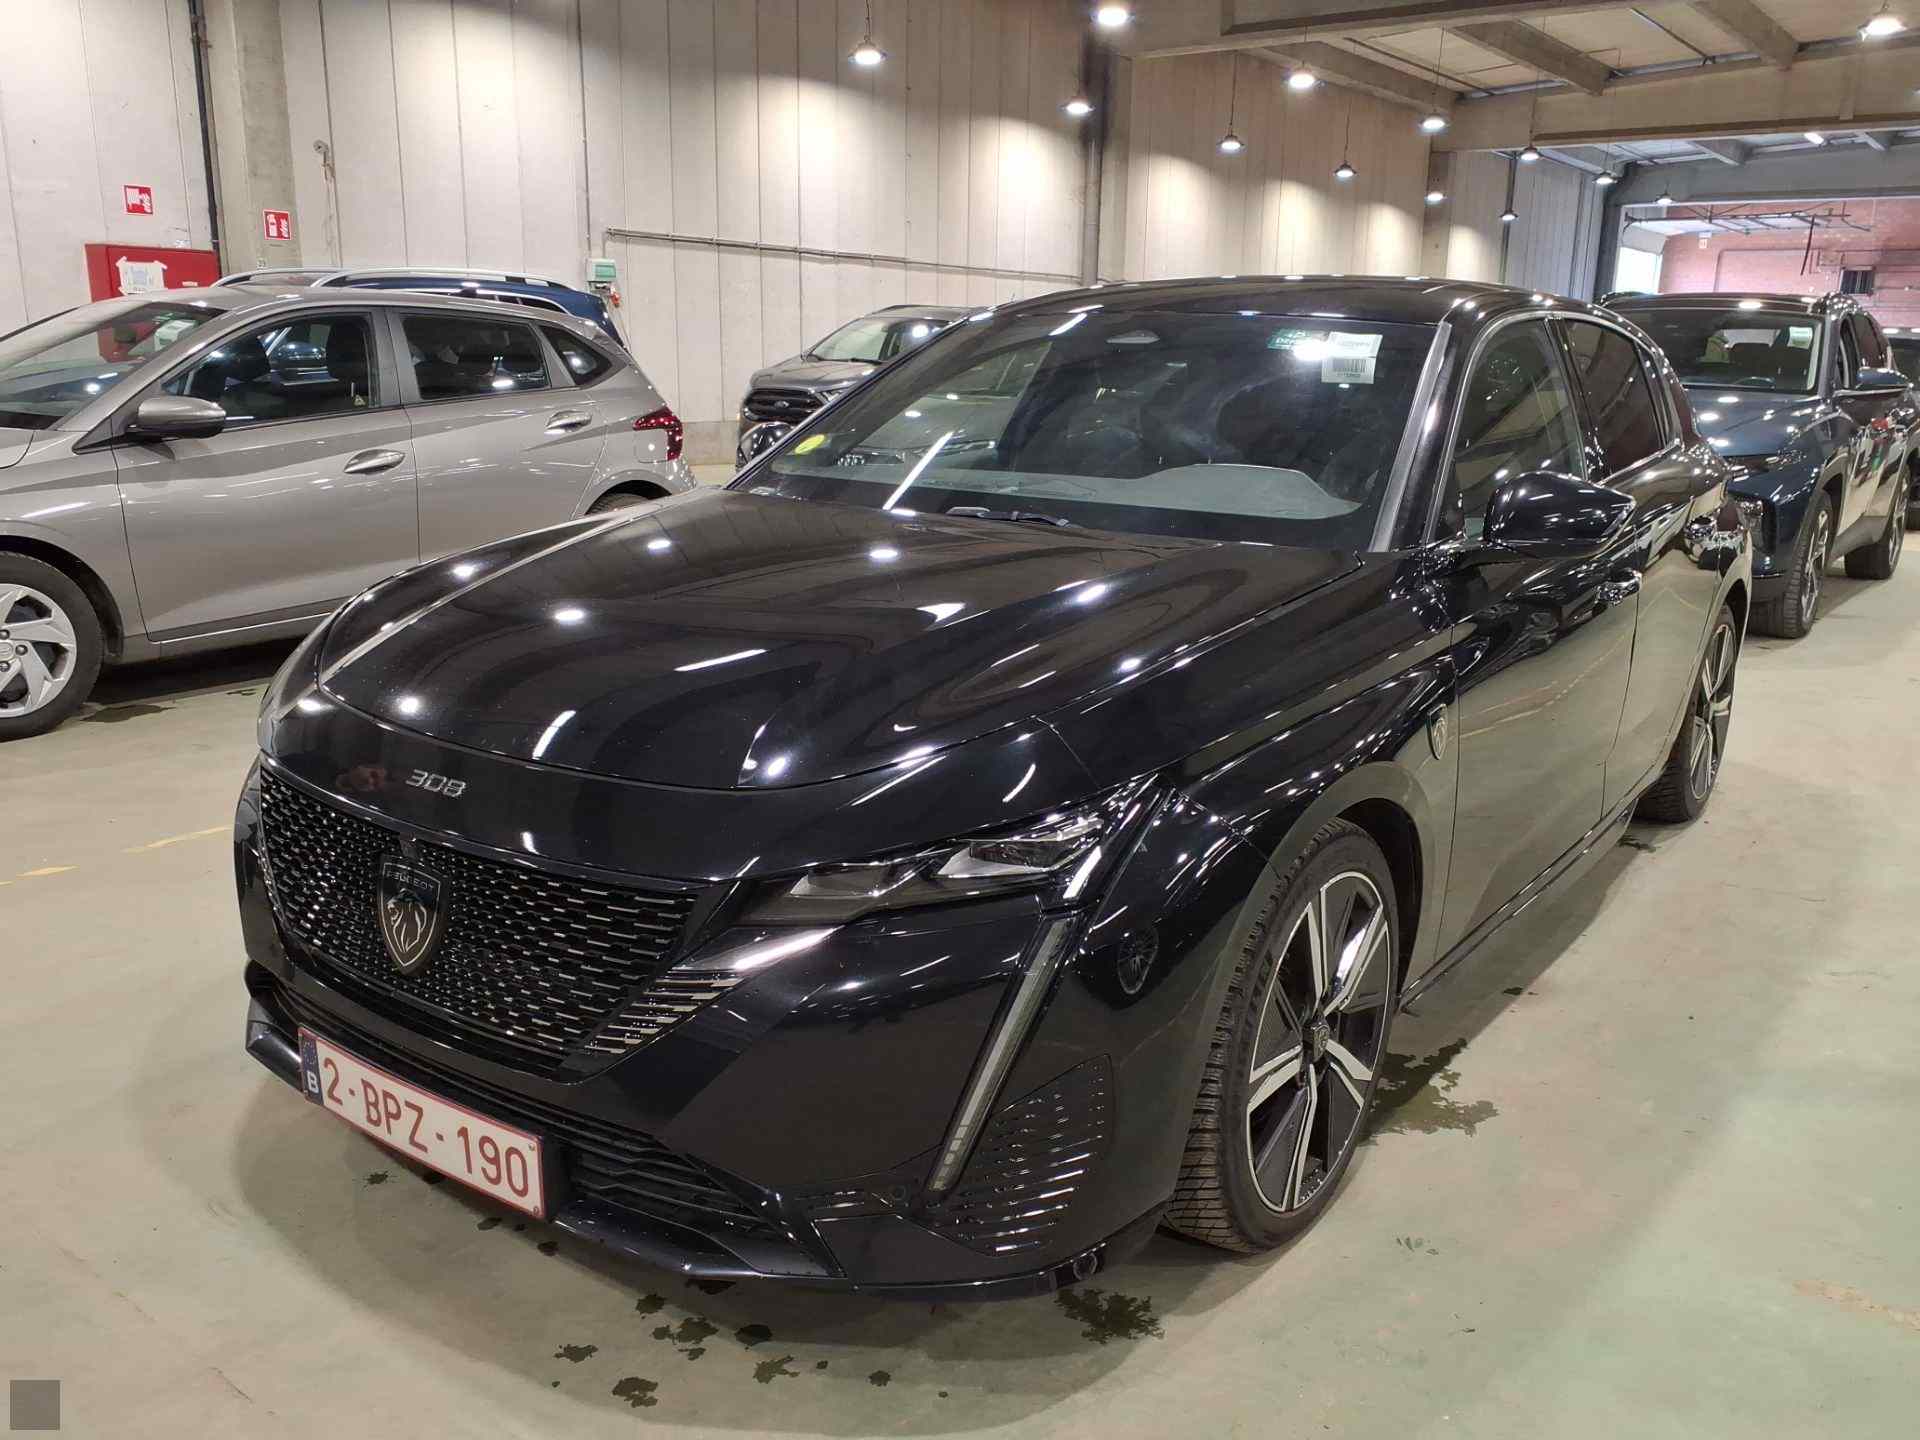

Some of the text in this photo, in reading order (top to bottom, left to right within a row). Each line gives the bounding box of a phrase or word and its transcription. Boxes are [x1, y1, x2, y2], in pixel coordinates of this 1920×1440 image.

[405, 768, 467, 798] 308
[305, 1070, 320, 1094] B
[323, 1056, 530, 1198] 2-BPZ-190
